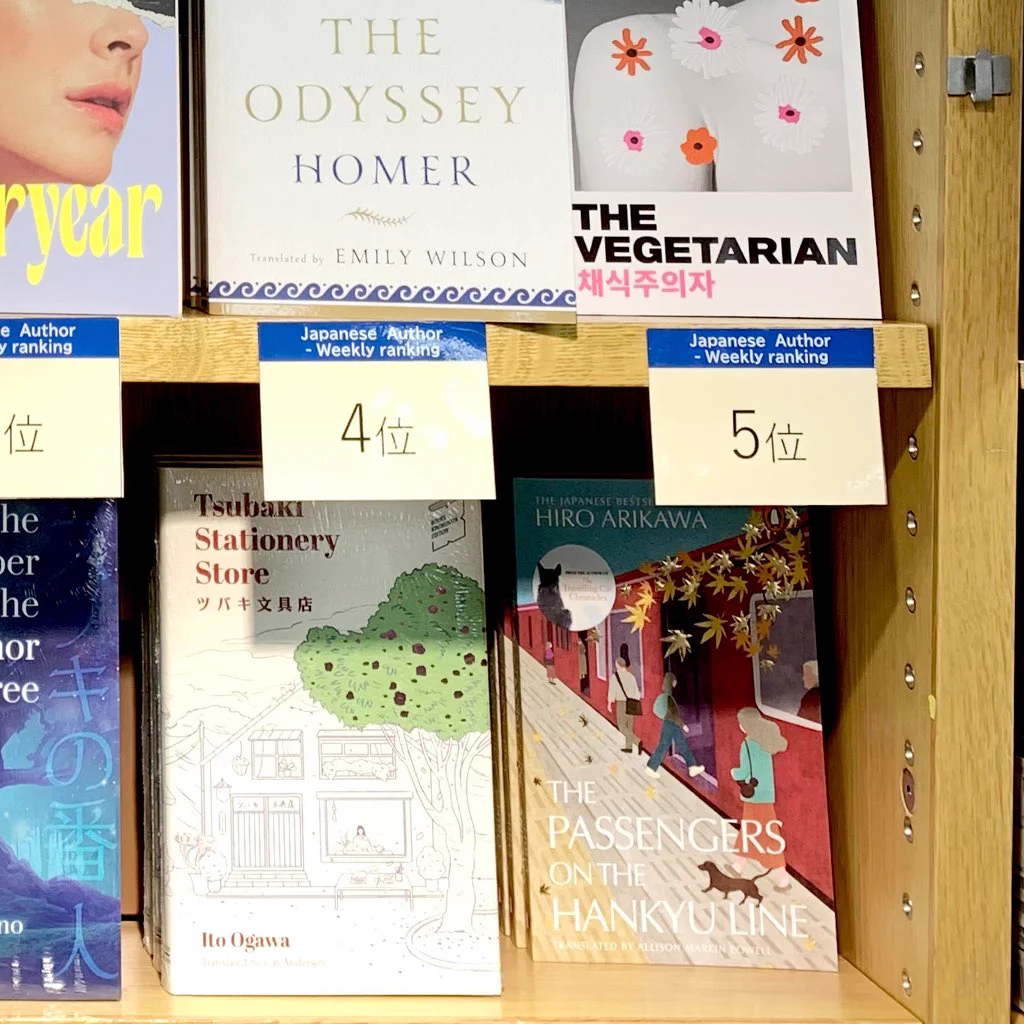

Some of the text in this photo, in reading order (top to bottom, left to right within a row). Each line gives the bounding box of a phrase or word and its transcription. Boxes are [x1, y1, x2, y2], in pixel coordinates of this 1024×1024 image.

[321, 18, 441, 55] THE
[244, 84, 525, 124] ODYSSEY
[291, 154, 478, 186] HOMER
[572, 204, 657, 231] THE
[249, 248, 528, 268] Translated by EMILY WILSON
[574, 236, 858, 265] VEGETARIAN
[578, 268, 715, 299] 채식주의자
[19, 323, 76, 339] Author
[300, 326, 443, 343] Japanese Author
[689, 332, 831, 350] Japanese Author
[12, 339, 73, 356] ranking
[317, 342, 441, 360] Weekly ranking
[705, 350, 829, 367] Weekly ranking
[340, 403, 417, 458] 4位
[731, 409, 807, 463] 5位
[560, 496, 610, 506] JAPANESE
[536, 508, 708, 529] HIRO ARIKAWA
[194, 527, 340, 558] Stationery
[195, 561, 269, 584] Store
[197, 596, 312, 612] ツバキ文具店
[547, 780, 596, 805] THE
[548, 815, 787, 854] PASSENGERS
[549, 861, 646, 887] ON THE
[552, 897, 809, 939] HANKYU LINE
[202, 932, 291, 952] Ito Ogawa
